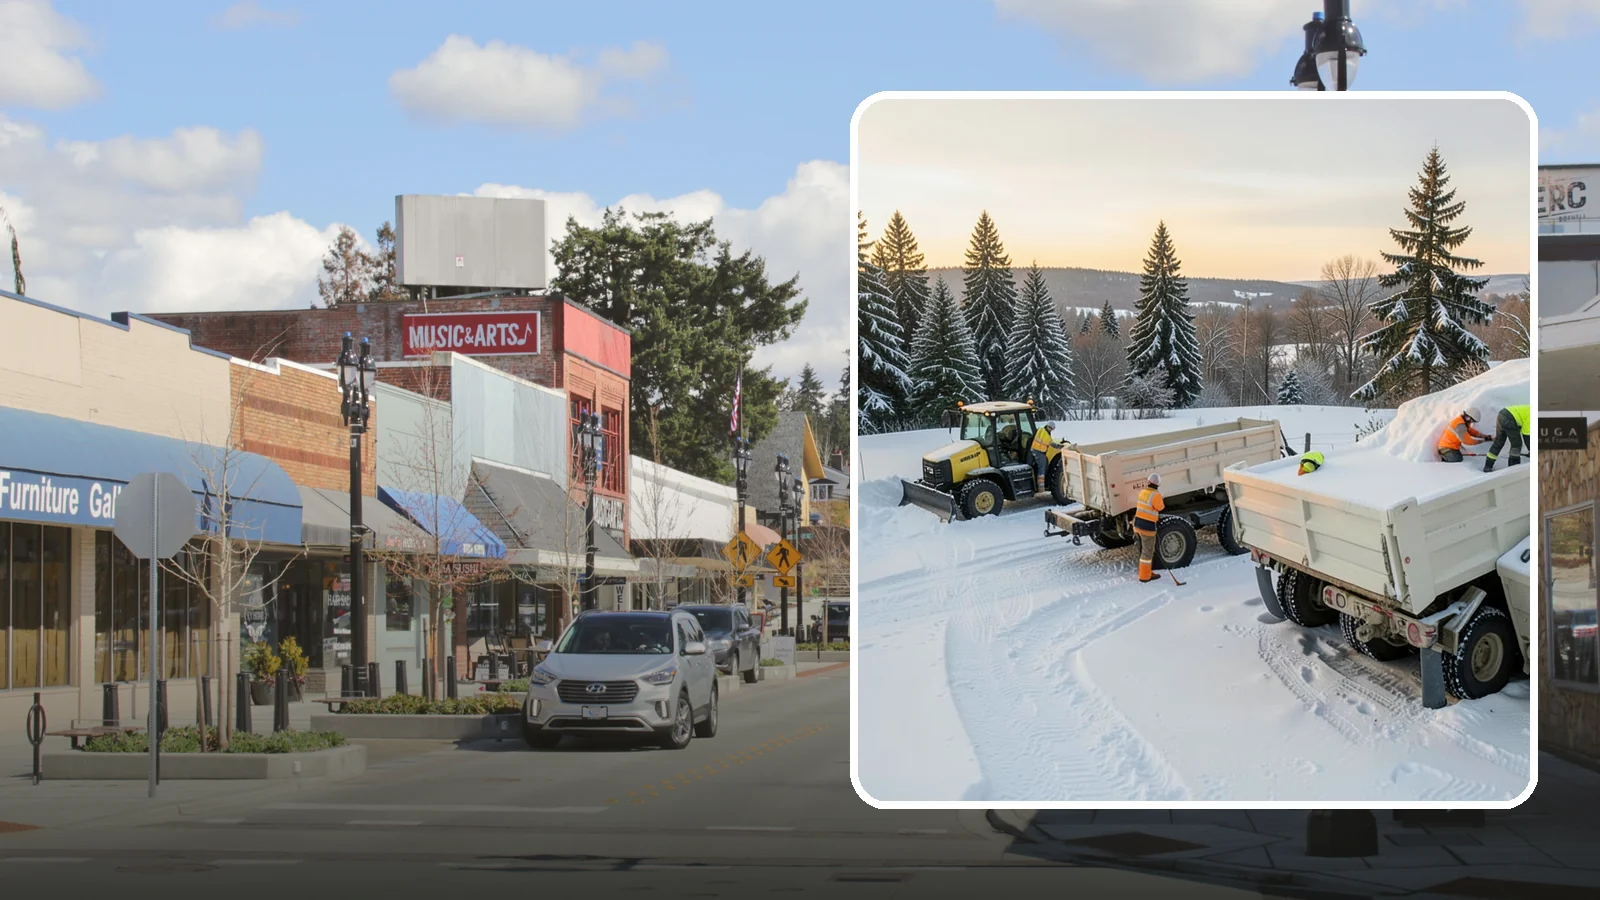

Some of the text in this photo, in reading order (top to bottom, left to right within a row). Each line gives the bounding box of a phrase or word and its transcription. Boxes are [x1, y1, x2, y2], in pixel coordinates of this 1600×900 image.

[409, 323, 520, 349] MUSIC&ARTS
[1540, 427, 1577, 436] UGA
[0, 471, 79, 515] Furniture
[453, 563, 479, 574] SUSHI
